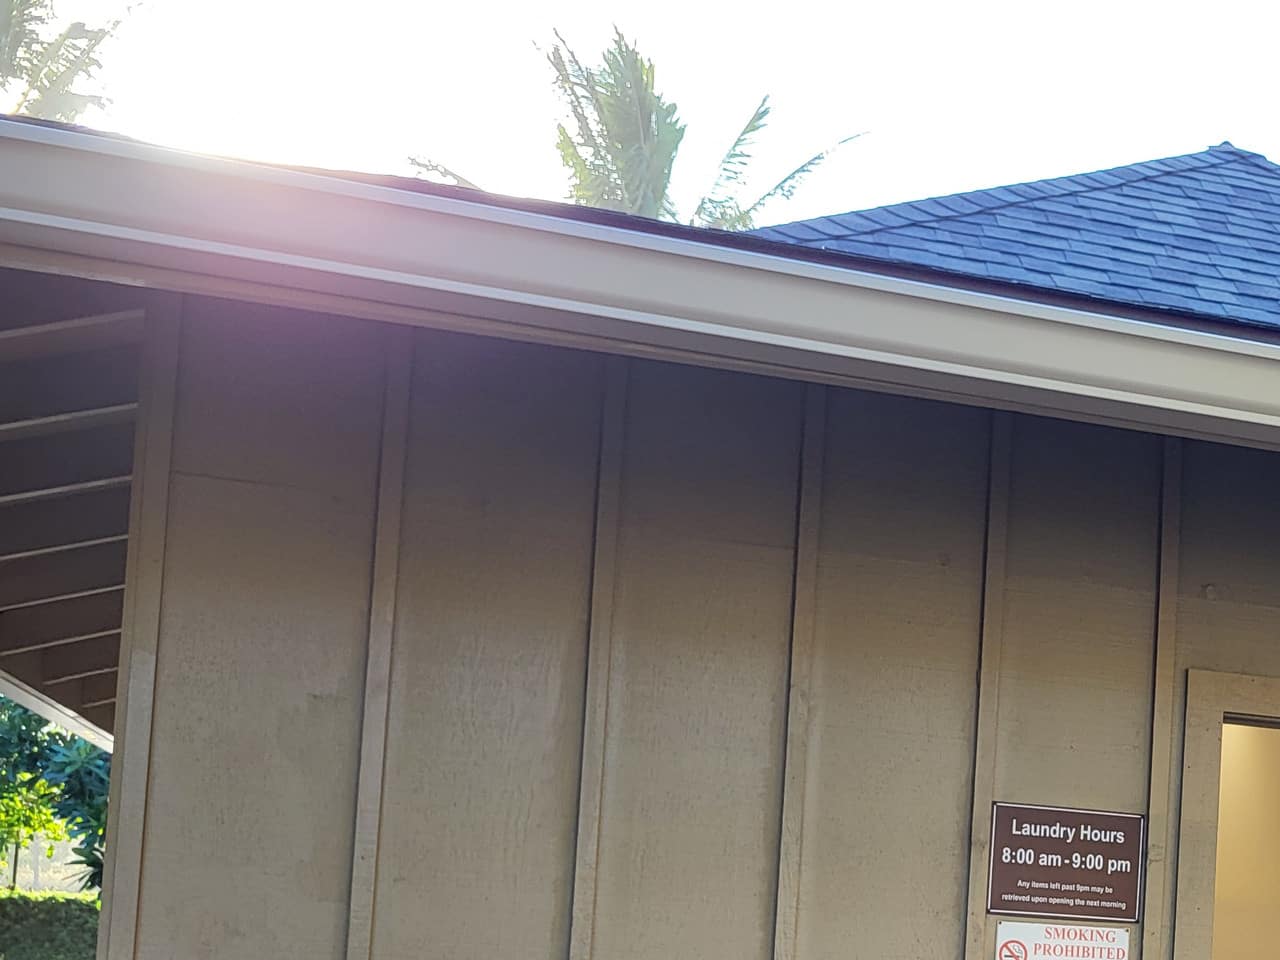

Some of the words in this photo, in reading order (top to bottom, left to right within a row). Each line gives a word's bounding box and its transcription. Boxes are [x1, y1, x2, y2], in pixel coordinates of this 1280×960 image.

[1012, 818, 1076, 843] Laundry
[1080, 824, 1125, 844] Hours
[1002, 847, 1034, 864] 8:00
[1039, 853, 1062, 867] am
[1072, 852, 1104, 870] 9:00
[1108, 858, 1131, 874] pm
[1017, 880, 1030, 889] Any
[1031, 880, 1048, 888] items
[1050, 882, 1060, 890] left
[1062, 884, 1076, 892] past
[1076, 884, 1090, 892] 9pm
[1090, 886, 1104, 894] may
[1002, 894, 1030, 902] retrieved
[1048, 897, 1074, 906] opening
[1074, 898, 1085, 906] the
[1100, 900, 1126, 910] morning
[1044, 926, 1116, 943] SMOKING
[1033, 943, 1126, 960] PROHIBITED
